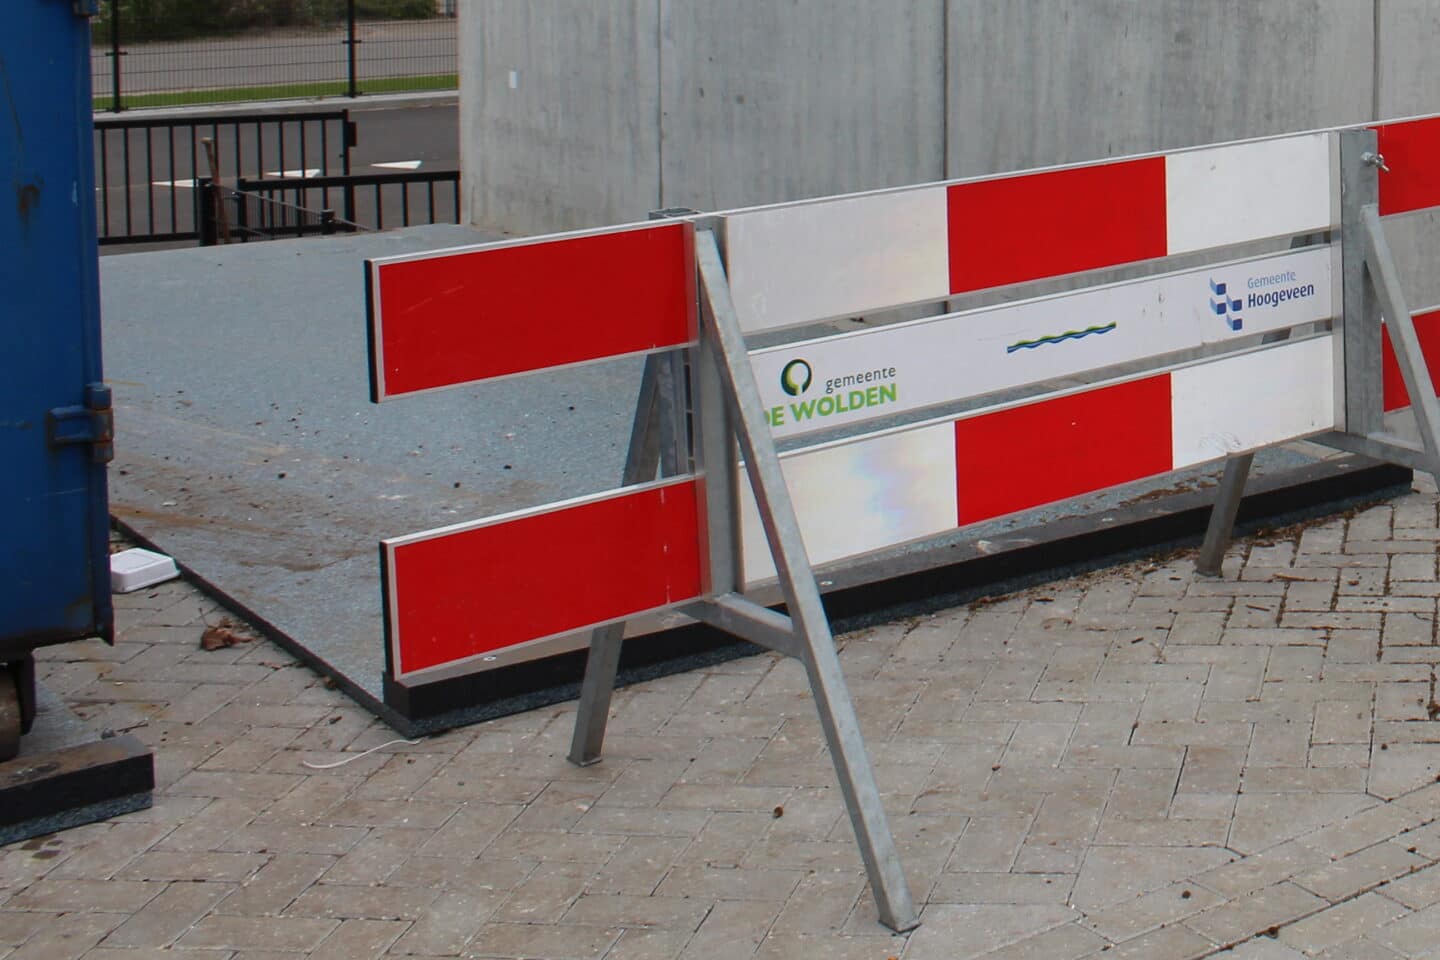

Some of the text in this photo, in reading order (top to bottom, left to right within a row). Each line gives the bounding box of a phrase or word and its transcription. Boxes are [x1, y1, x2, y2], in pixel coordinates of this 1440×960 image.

[1247, 271, 1296, 289] Gemeente
[1247, 284, 1314, 308] Hoogeveen
[825, 367, 896, 394] gemeente
[790, 383, 897, 422] WOLDEN
